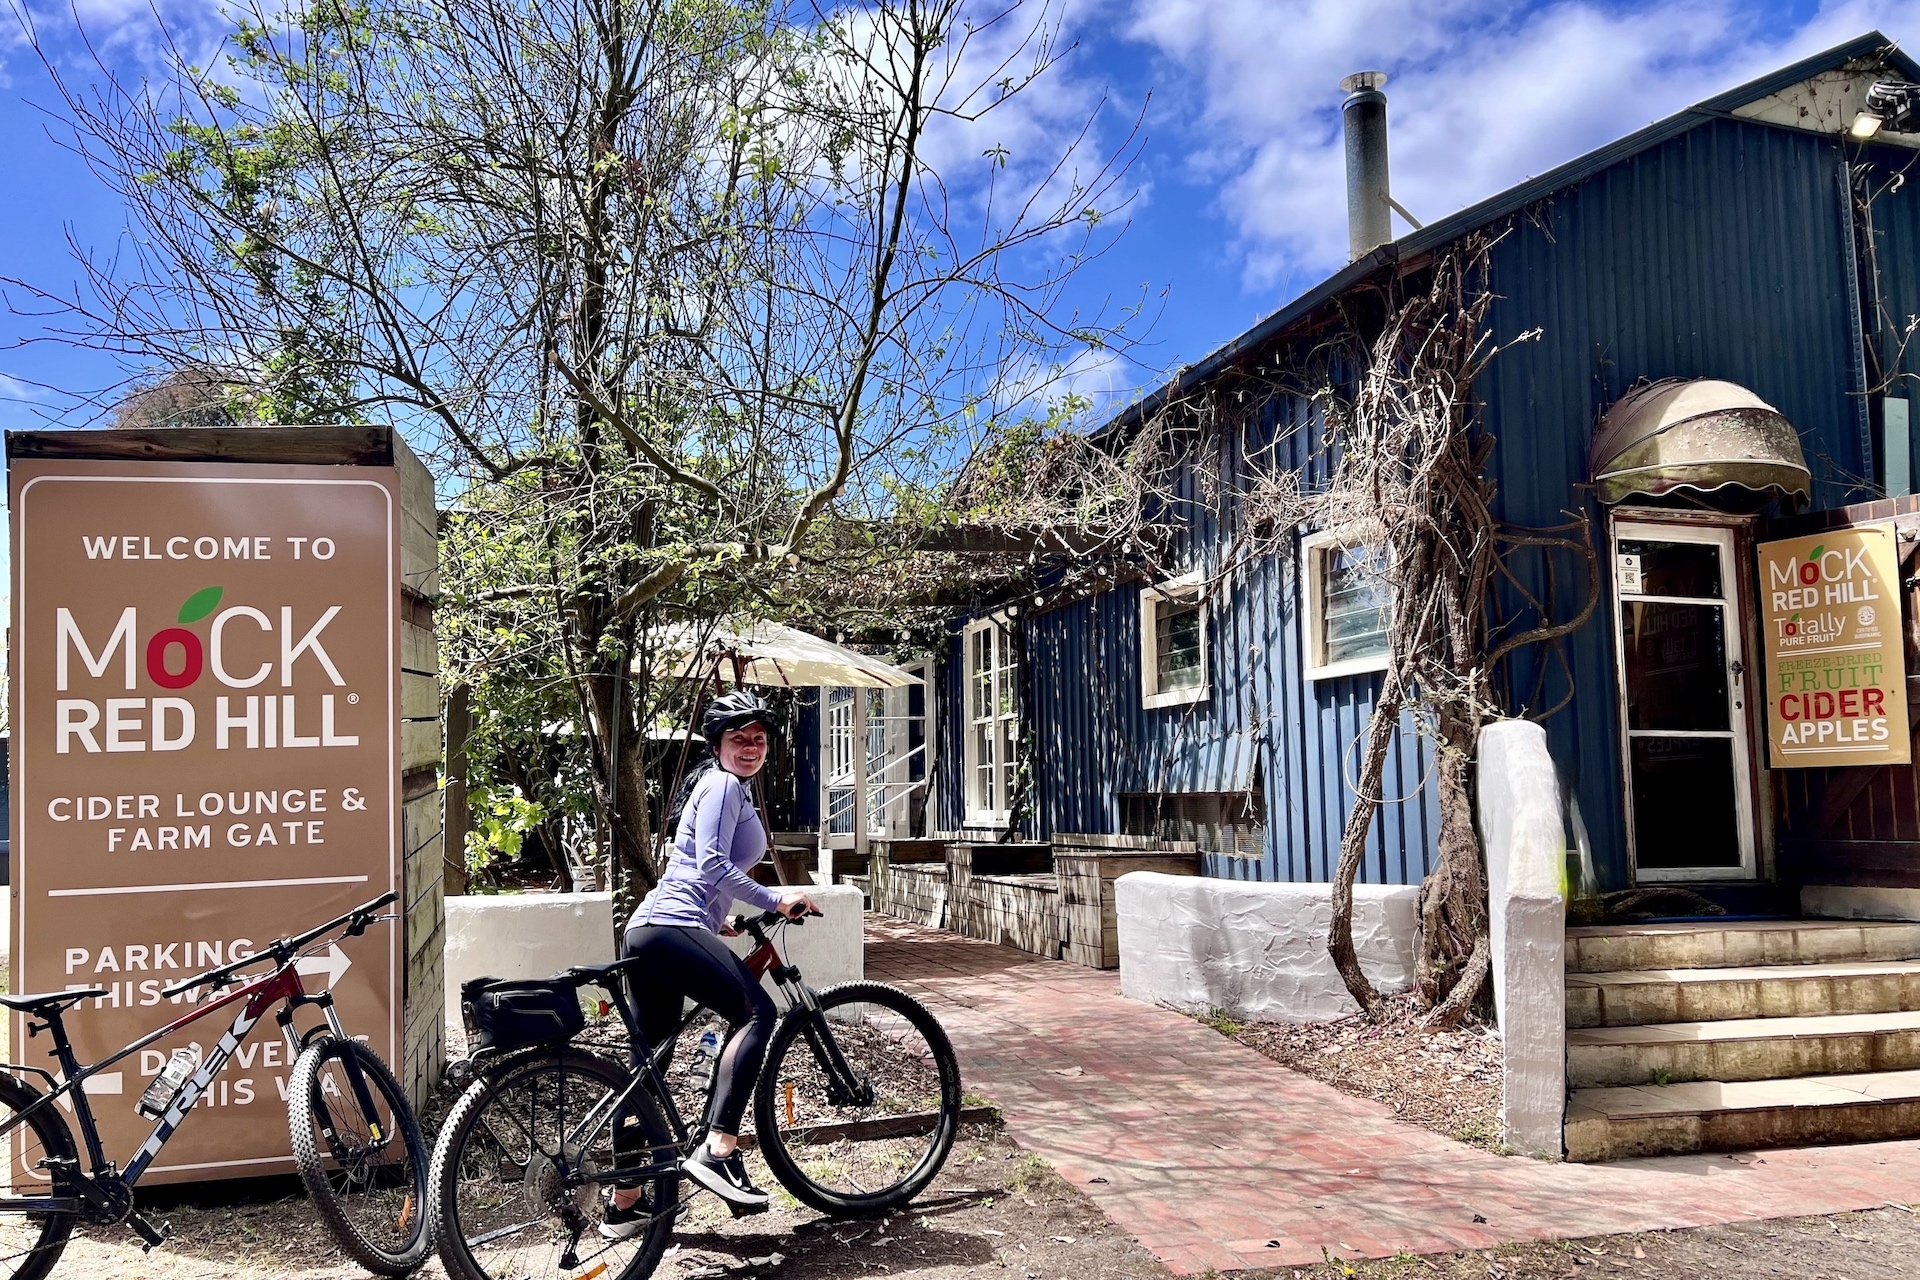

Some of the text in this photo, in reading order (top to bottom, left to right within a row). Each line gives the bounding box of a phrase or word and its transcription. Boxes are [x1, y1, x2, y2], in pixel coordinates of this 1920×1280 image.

[82, 535, 336, 561] WELCOME TO
[1772, 579, 1880, 612] RED HILL
[1773, 612, 1847, 637] Totally
[1780, 633, 1836, 647] PURE FRUIT
[1778, 652, 1883, 671] FREEZE-DRIED
[1778, 664, 1884, 693] FRUIT
[1779, 688, 1887, 721] CIDER
[56, 697, 197, 754] RED
[1781, 718, 1890, 745] APPLES
[47, 787, 368, 822] CIDER LOUNGE &
[108, 820, 325, 852] FARM GATE
[65, 938, 256, 976] PARKING
[496, 1066, 525, 1088] COMP
[190, 1078, 256, 1108] HIS
